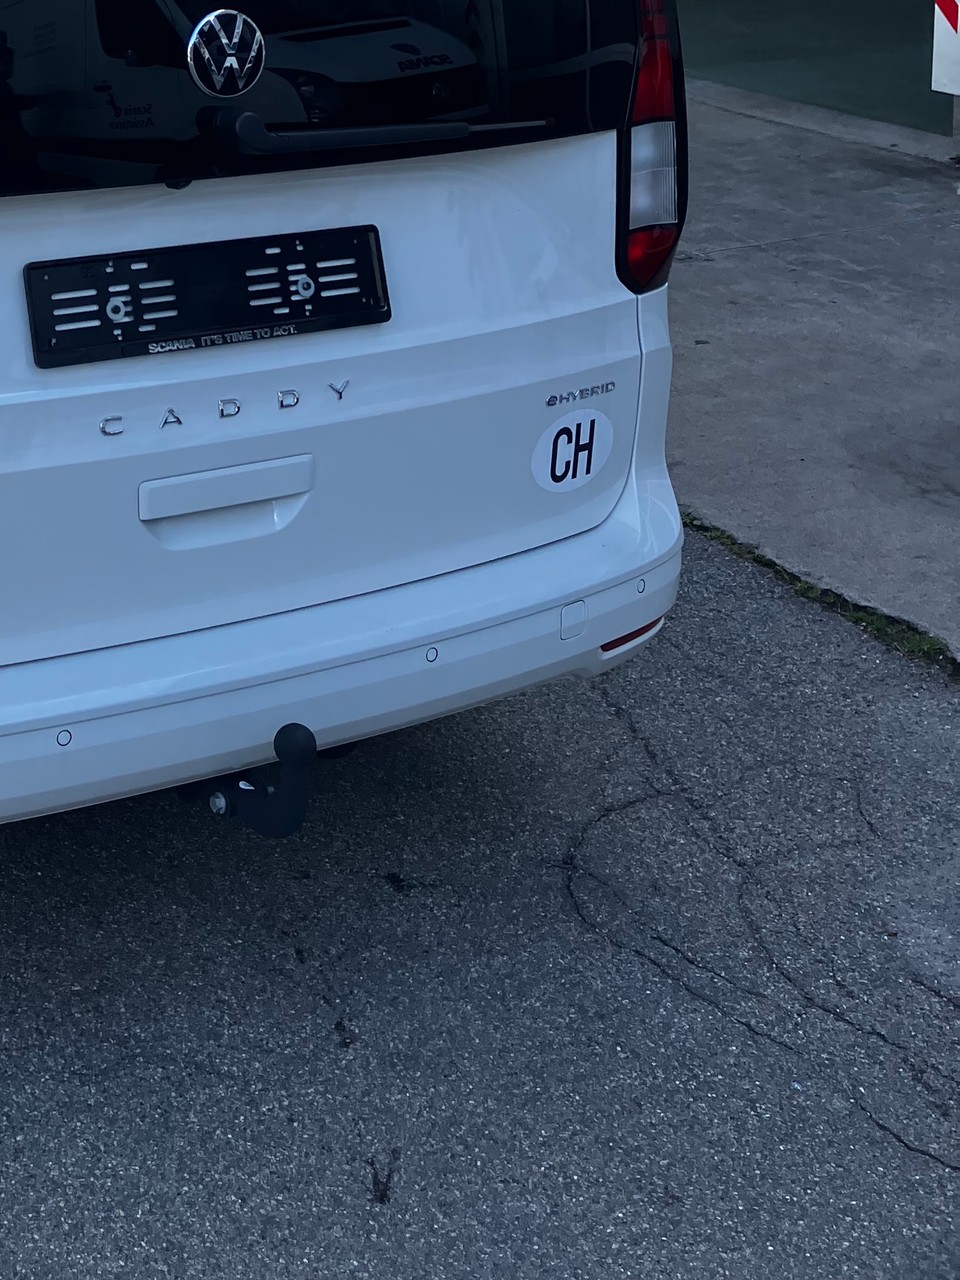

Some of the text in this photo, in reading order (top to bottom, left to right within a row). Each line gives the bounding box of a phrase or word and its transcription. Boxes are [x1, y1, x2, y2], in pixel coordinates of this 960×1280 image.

[148, 324, 298, 353] SCANIA IT'S TIME TO ACT.
[98, 380, 351, 437] CADDY
[546, 381, 616, 407] eHYBRID
[550, 418, 596, 484] CH
